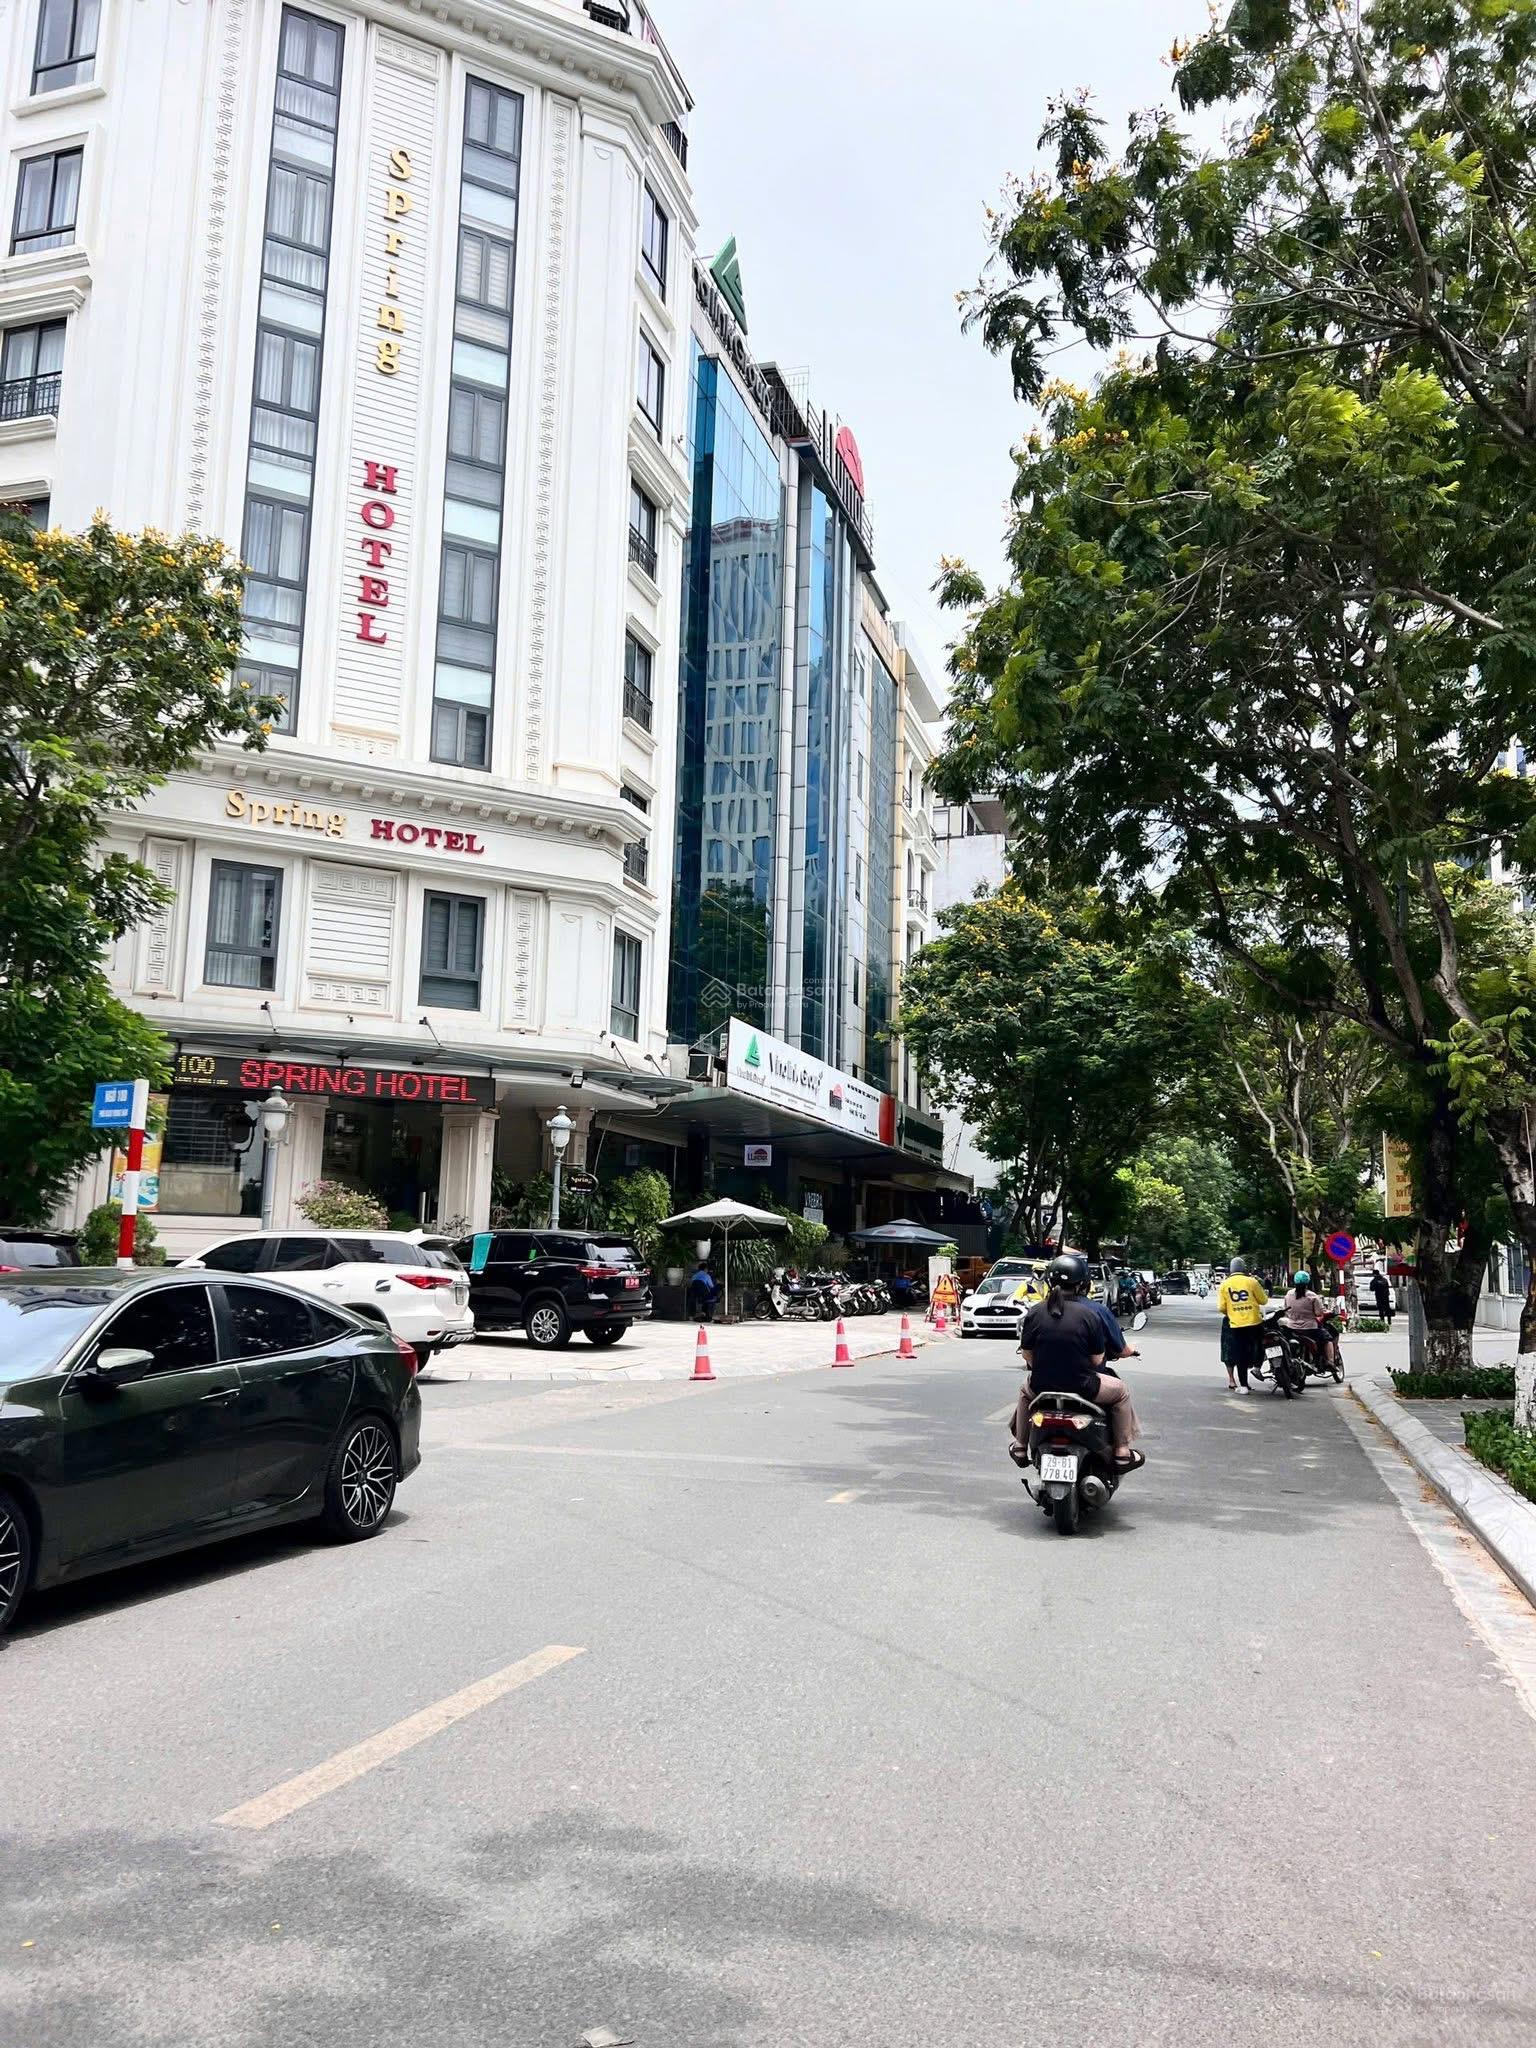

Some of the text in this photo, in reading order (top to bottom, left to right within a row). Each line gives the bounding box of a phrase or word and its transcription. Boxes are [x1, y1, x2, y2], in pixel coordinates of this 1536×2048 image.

[376, 148, 412, 376] Spring
[356, 460, 398, 645] HOTEL
[225, 789, 485, 855] Spring HOTEL
[239, 1059, 477, 1102] SPRING HOTEL
[1228, 1287, 1249, 1302] be
